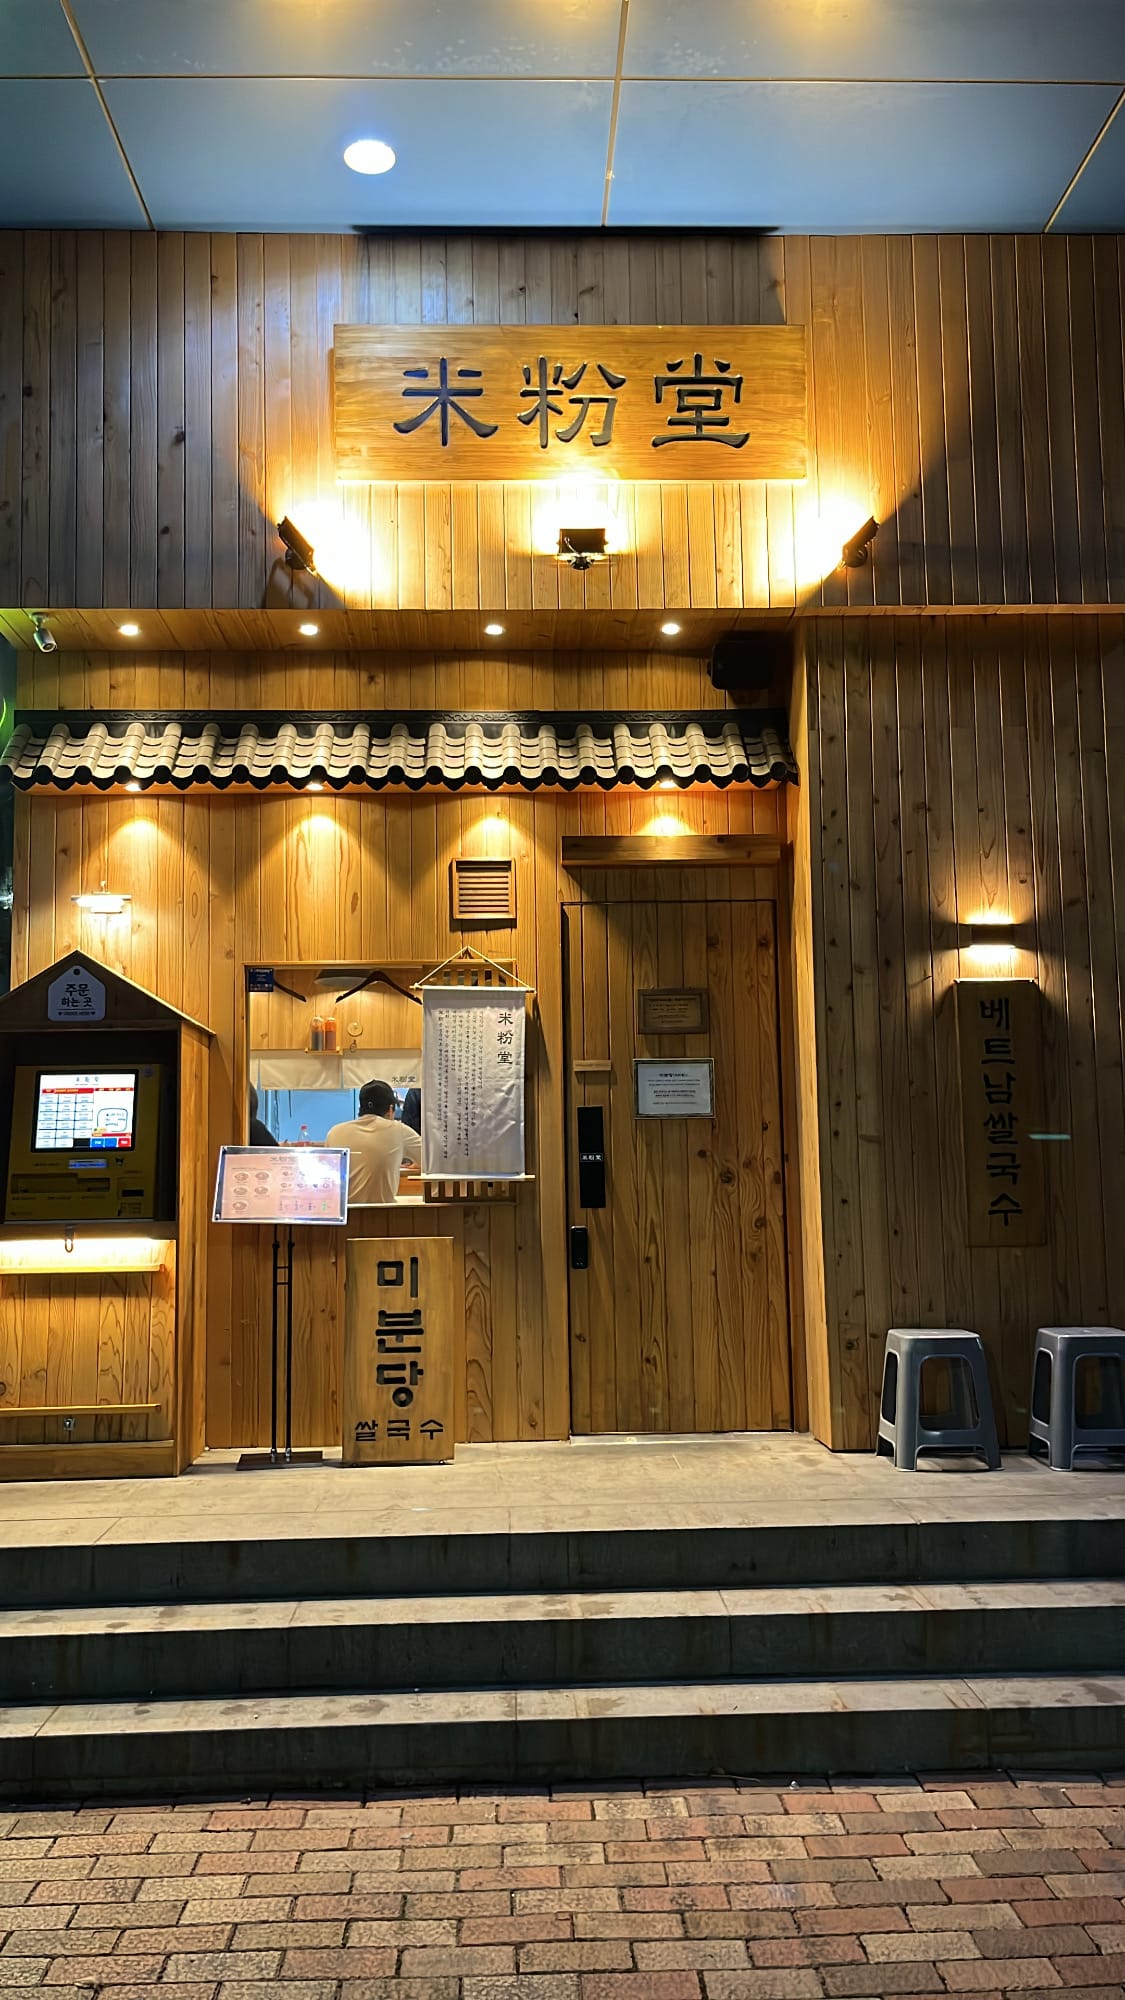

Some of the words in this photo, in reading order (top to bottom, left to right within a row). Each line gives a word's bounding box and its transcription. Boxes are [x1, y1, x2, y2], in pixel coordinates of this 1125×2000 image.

[393, 352, 750, 449] 米粉堂
[61, 997, 80, 1007] 하는
[83, 997, 93, 1007] 곳
[65, 983, 90, 997] 주문
[496, 1011, 514, 1065] 米粉堂
[979, 997, 1023, 1227] 베트남쌀국수
[375, 1256, 424, 1407] 미분당
[355, 1419, 443, 1442] 쌀국수
